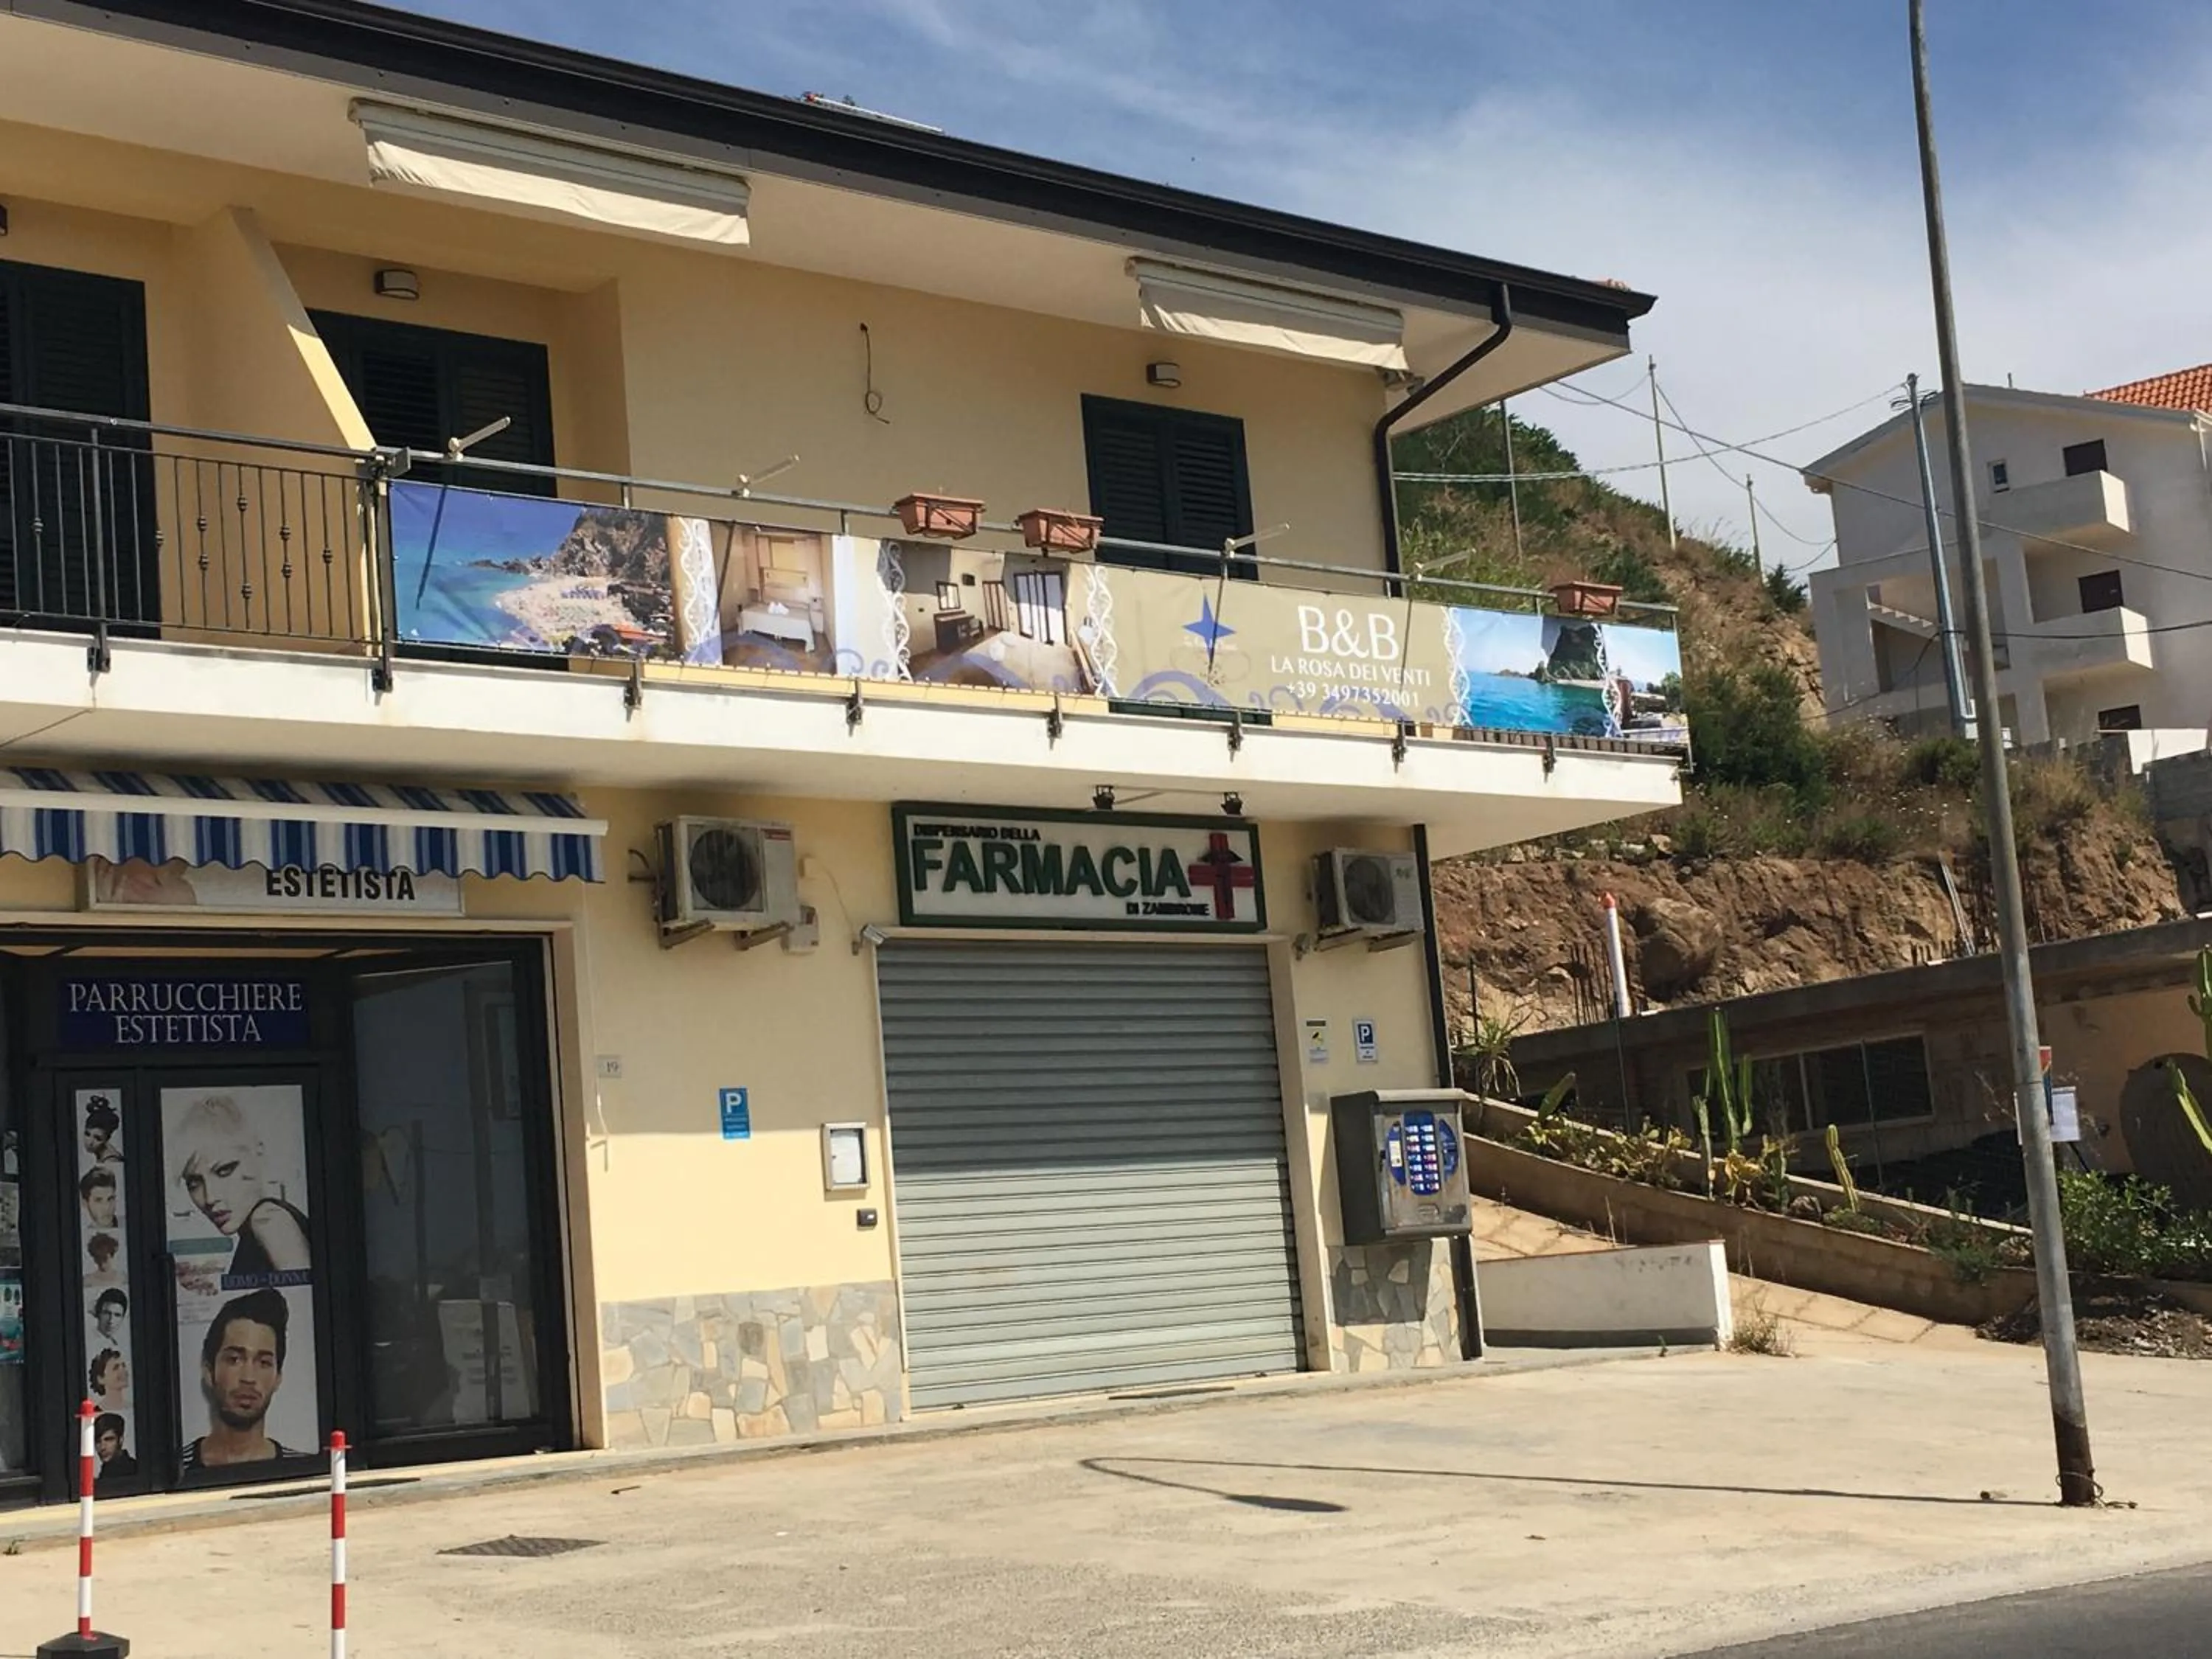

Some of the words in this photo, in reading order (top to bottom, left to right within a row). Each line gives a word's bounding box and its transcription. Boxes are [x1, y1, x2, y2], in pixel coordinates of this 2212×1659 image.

[1297, 605, 1399, 661] B&B
[1270, 655, 1295, 674] LA
[1298, 657, 1346, 679] ROSA
[1349, 662, 1378, 682] DEI
[1380, 665, 1432, 687] VENTI
[1285, 681, 1317, 699] +39
[1321, 683, 1420, 708] 3497352001
[265, 866, 416, 900] ESTETISTA
[911, 838, 1193, 899] FARMACIA
[1125, 901, 1140, 916] DI
[68, 983, 303, 1013] PARRUCCHIERE
[114, 1013, 262, 1045] ESTETISTA
[1360, 1026, 1371, 1043] P
[725, 1092, 742, 1113] P
